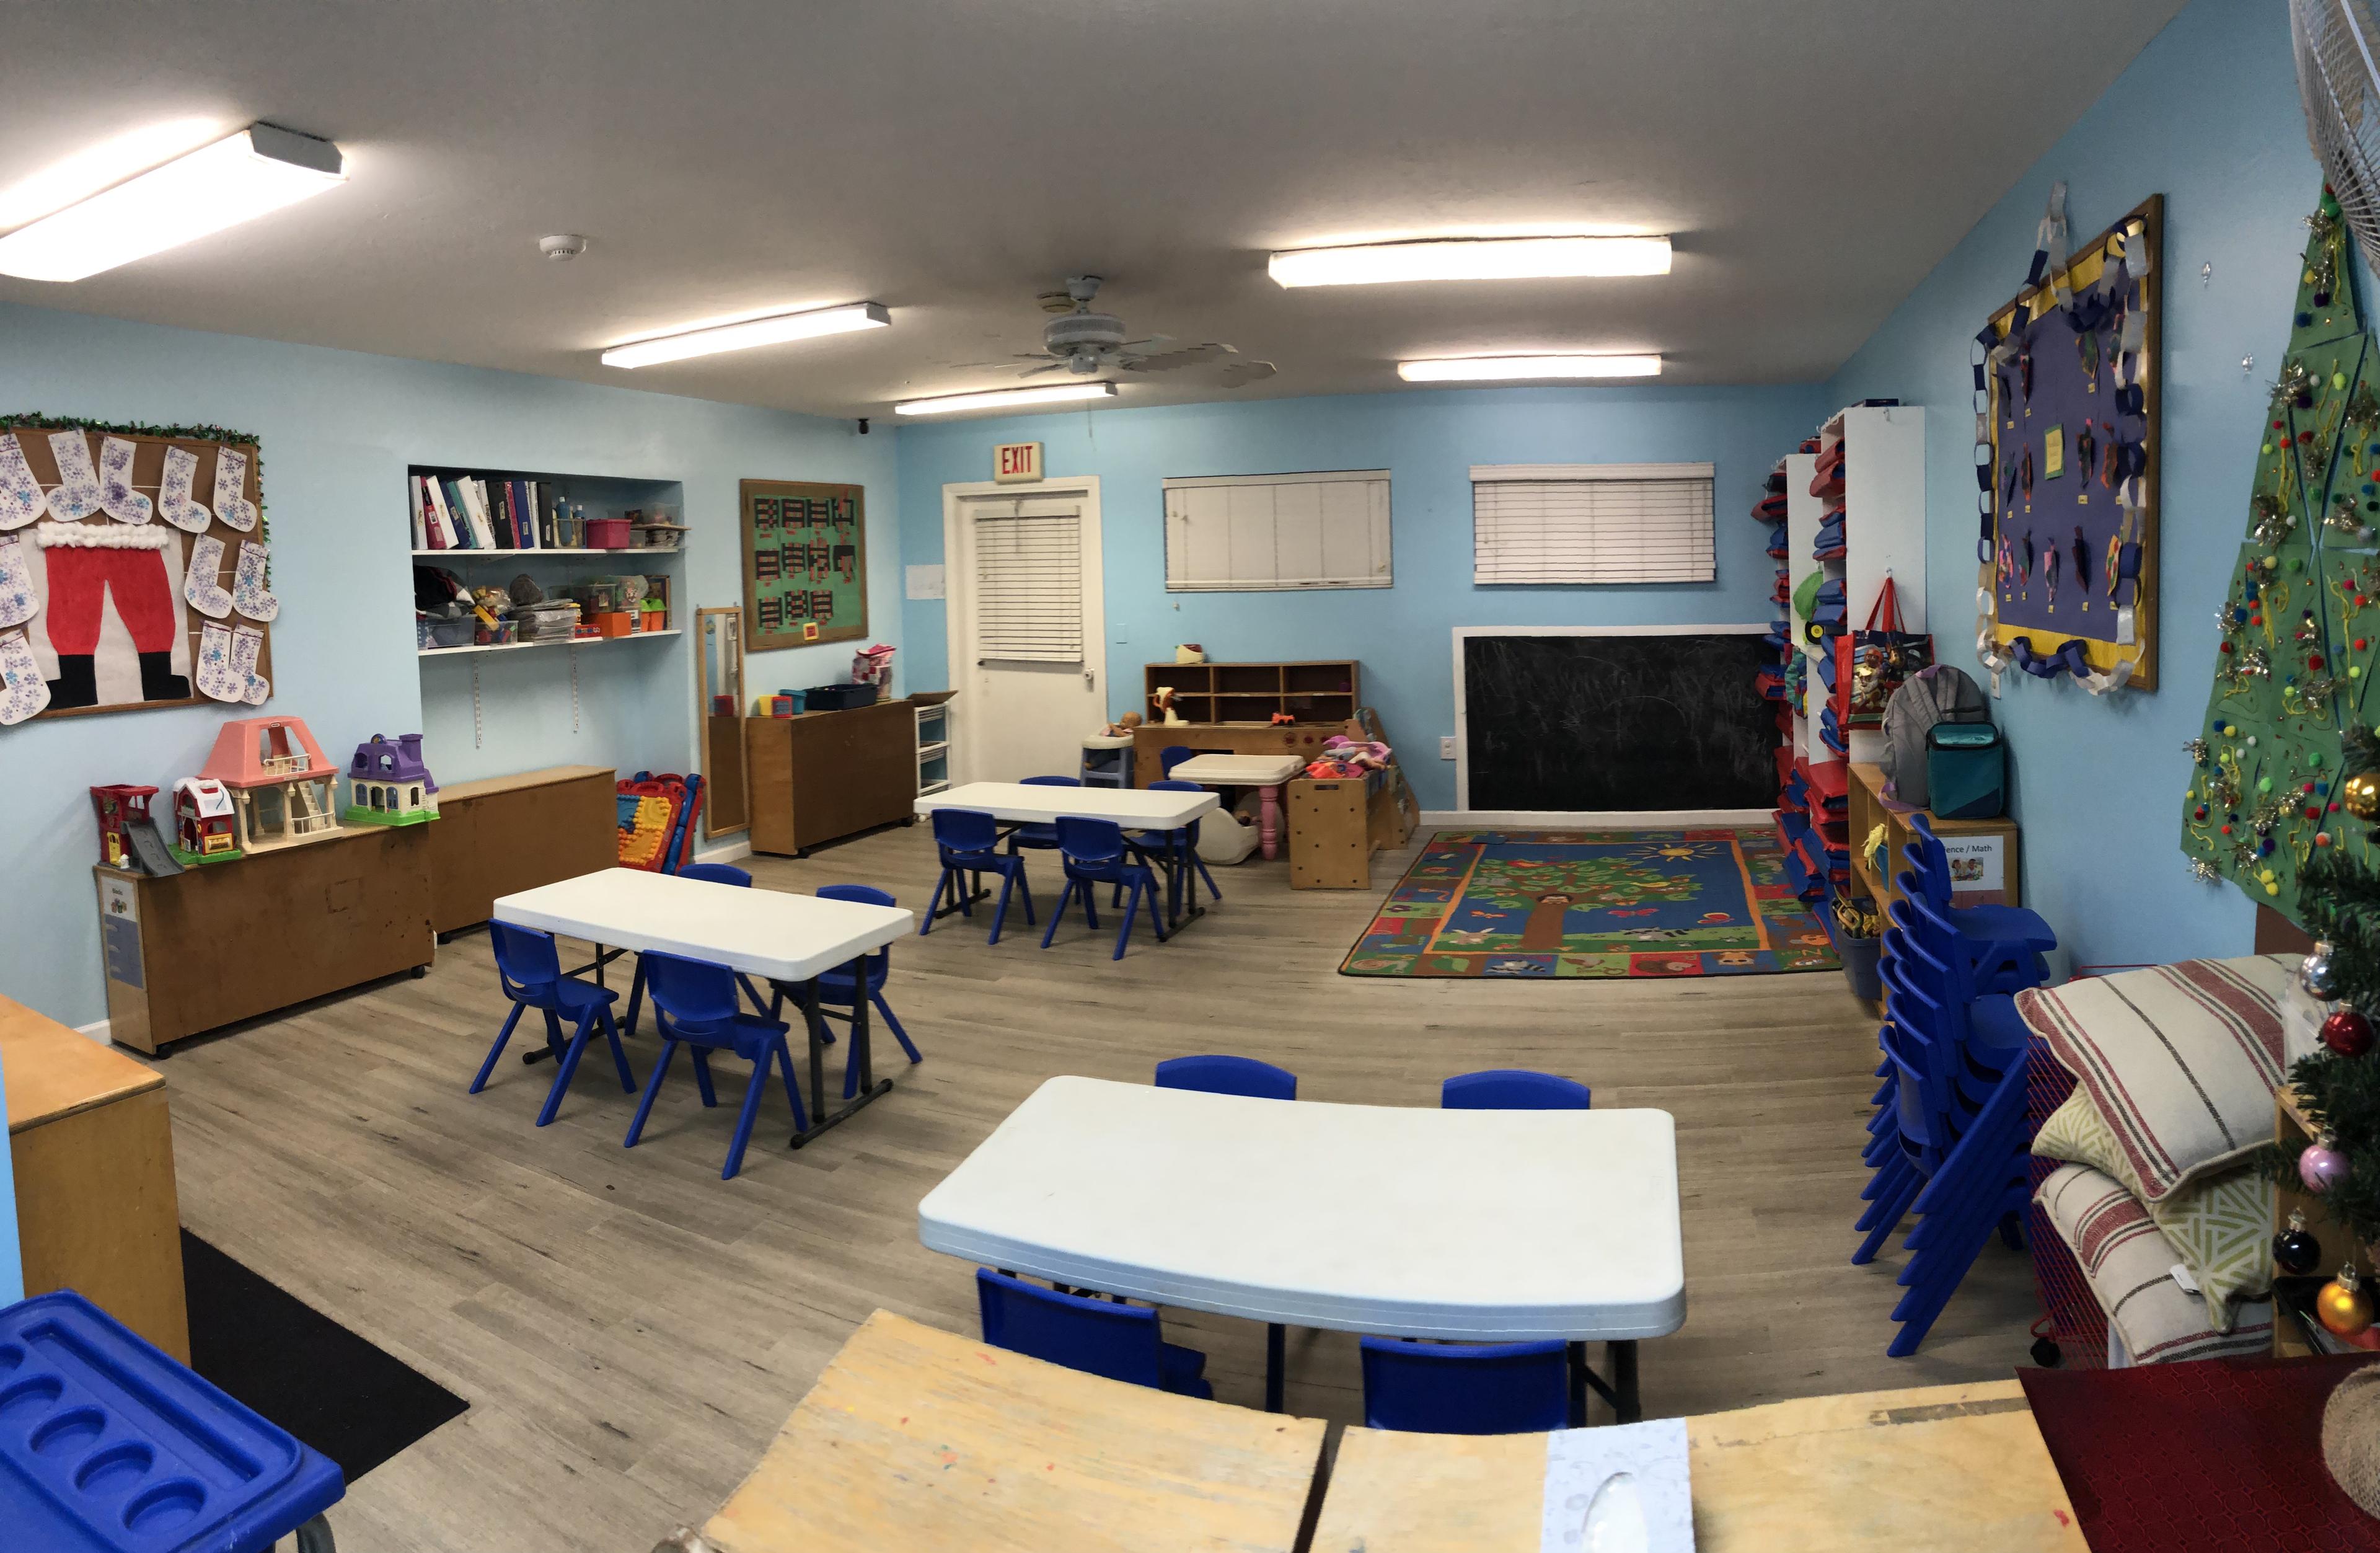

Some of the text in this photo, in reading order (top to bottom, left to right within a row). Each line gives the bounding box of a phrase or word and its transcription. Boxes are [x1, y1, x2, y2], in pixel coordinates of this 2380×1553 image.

[1002, 446, 1033, 474] EXIT
[1966, 845, 1970, 853] /
[1972, 844, 1992, 852] Math
